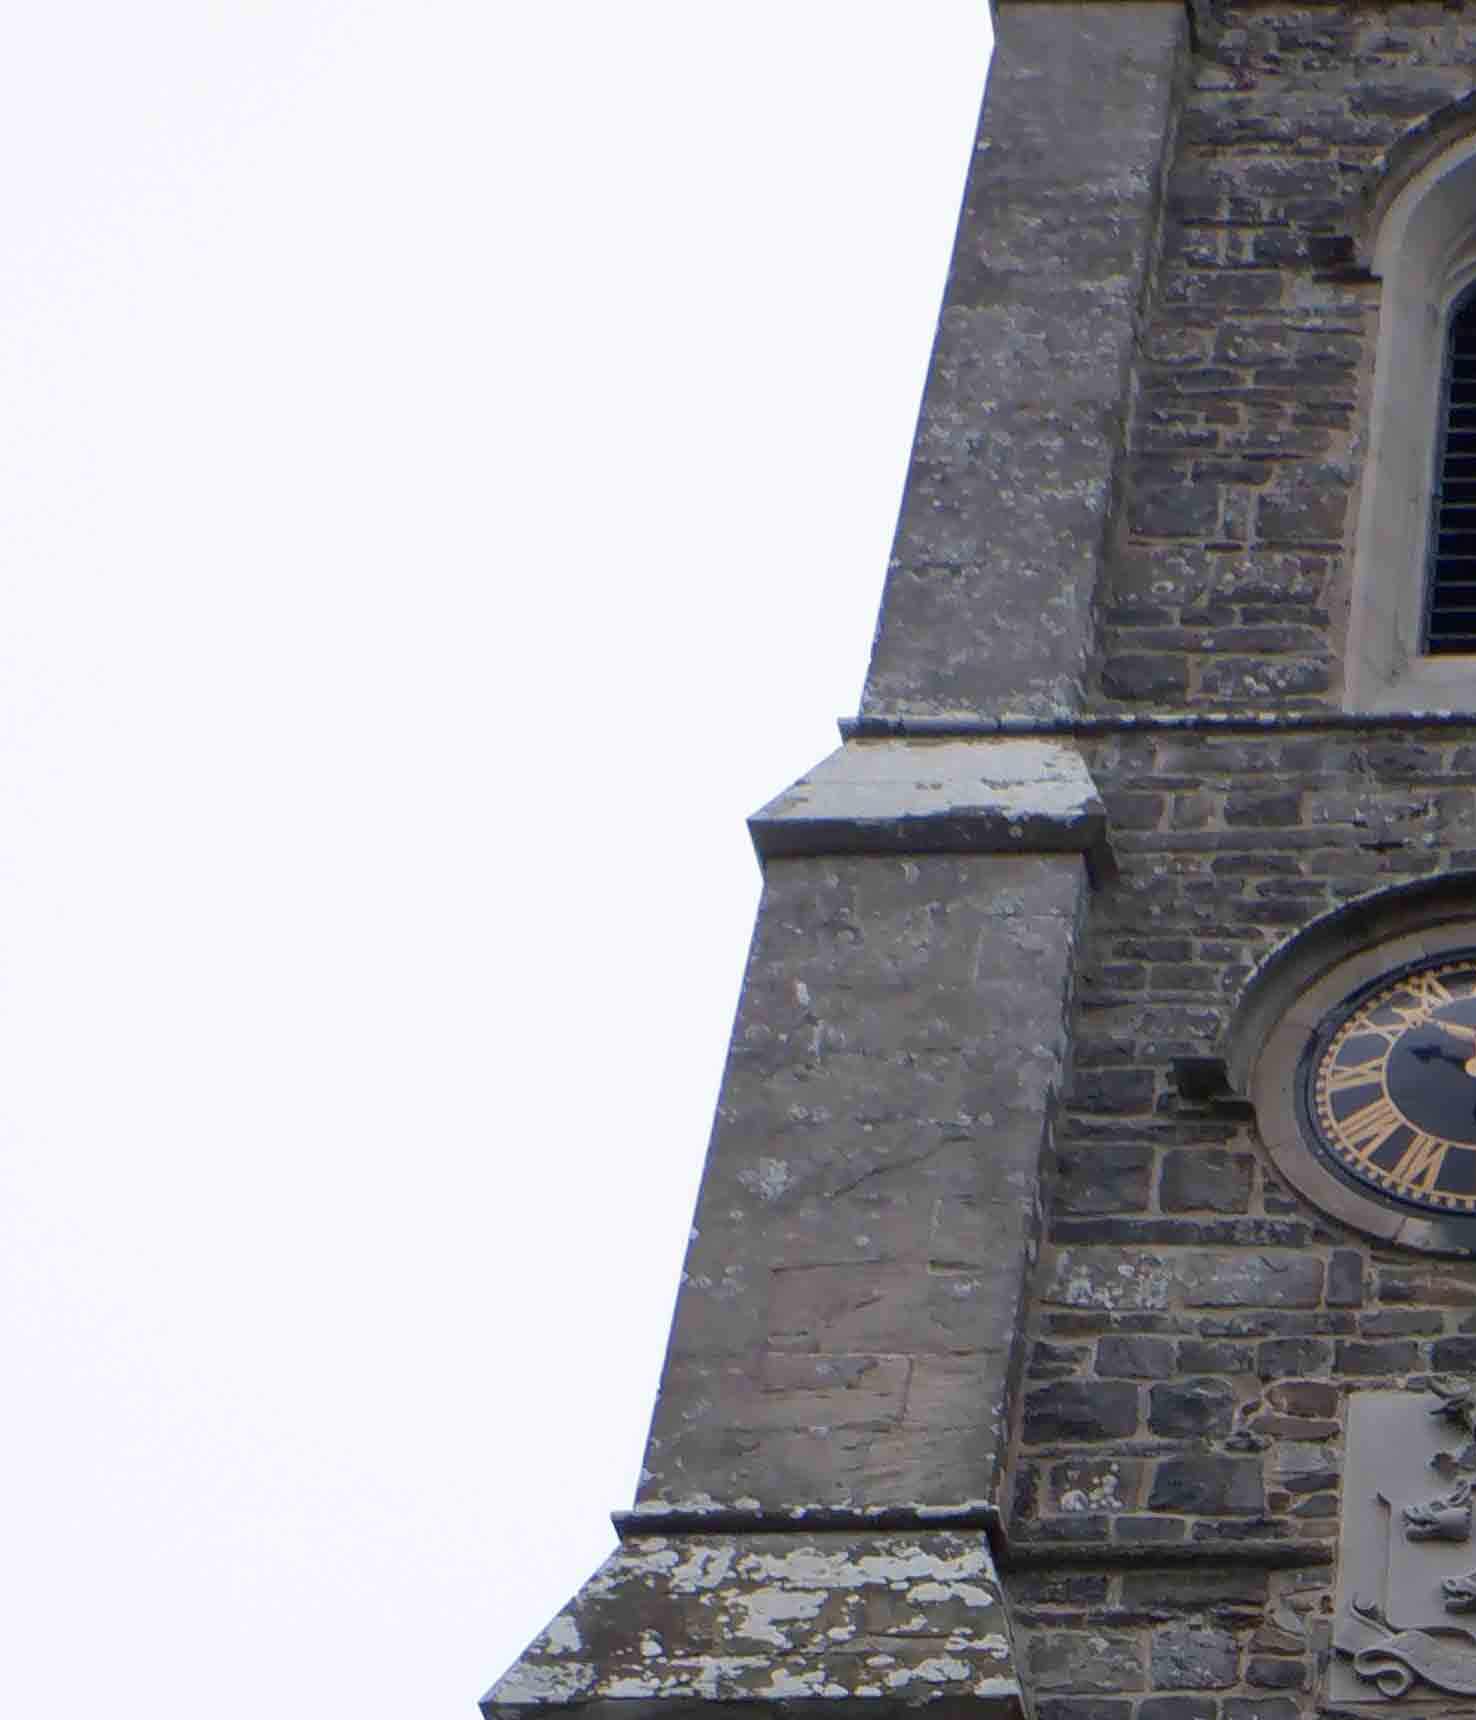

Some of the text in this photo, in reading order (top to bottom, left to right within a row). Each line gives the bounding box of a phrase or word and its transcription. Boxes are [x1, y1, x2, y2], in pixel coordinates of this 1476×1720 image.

[1329, 1057, 1386, 1089] IX
[1337, 1096, 1407, 1160] VIII
[1390, 1135, 1449, 1192] VII
